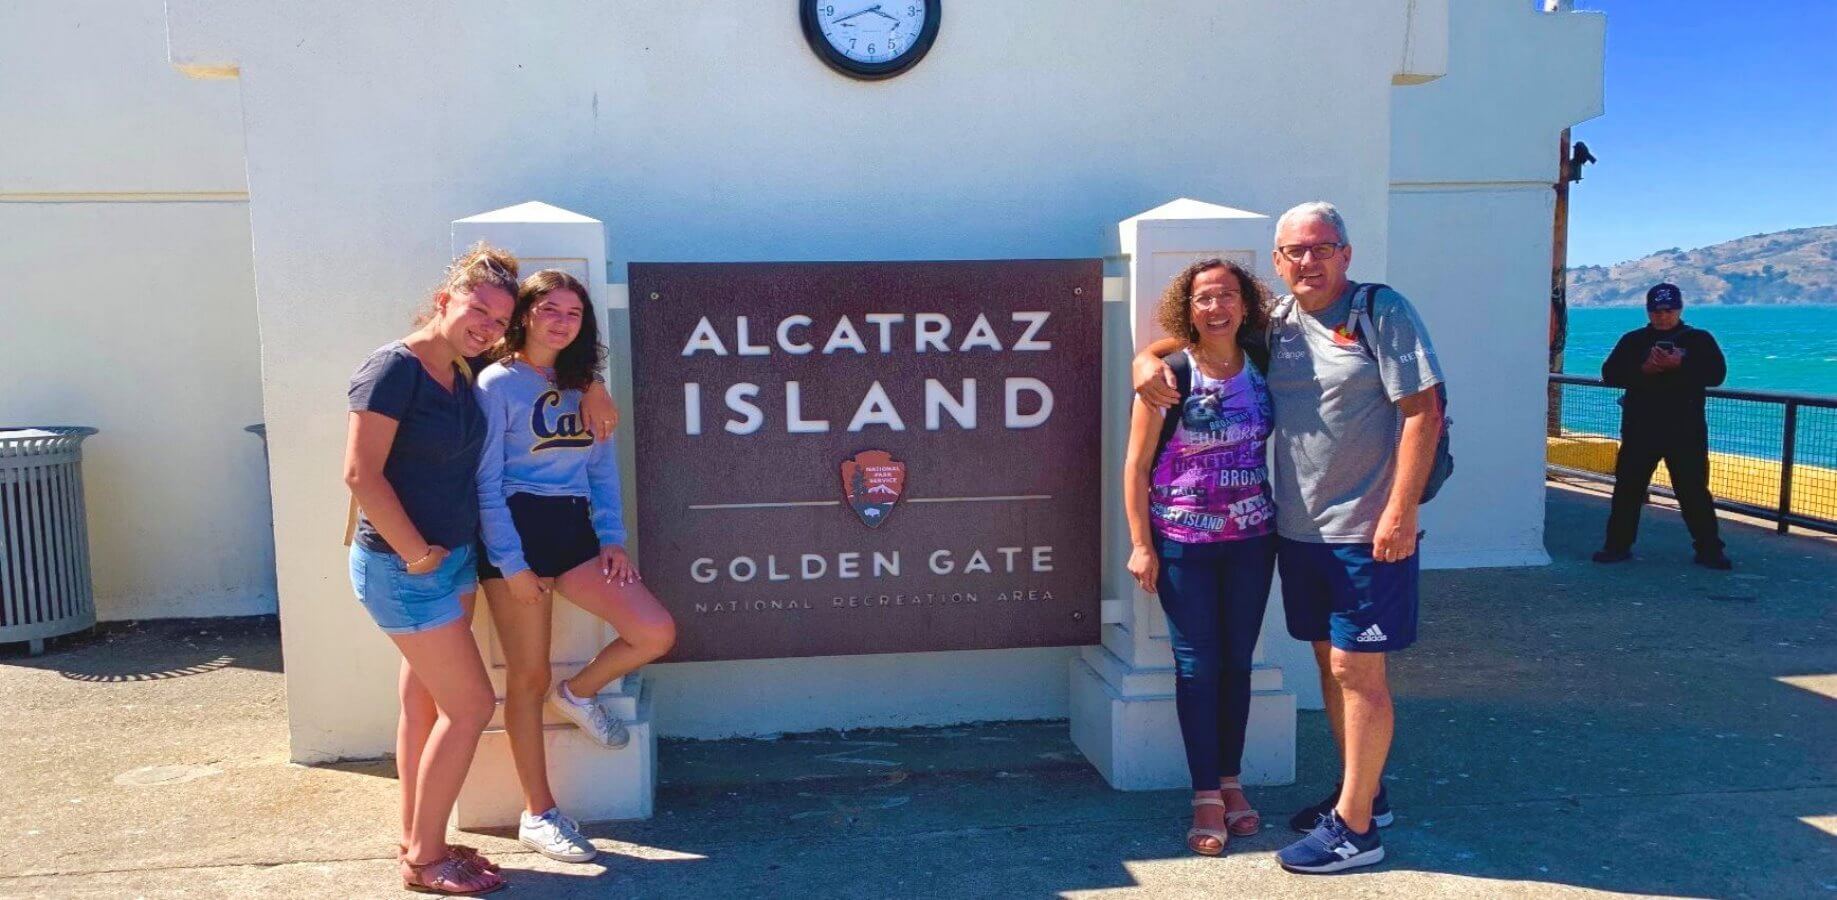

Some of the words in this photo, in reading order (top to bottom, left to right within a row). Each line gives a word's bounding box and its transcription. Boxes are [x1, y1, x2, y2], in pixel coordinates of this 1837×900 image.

[826, 5, 834, 16] 9
[907, 6, 916, 17] 3
[849, 38, 857, 49] 7
[867, 43, 875, 54] 6
[888, 39, 896, 49] 5
[681, 311, 1052, 356] ALCATRAZ
[683, 377, 1055, 435] ISLAND
[1183, 511, 1224, 530] ISLAND
[690, 551, 900, 583] GOLDEN
[928, 545, 1055, 576] GATE
[695, 600, 814, 613] NATIONAL
[832, 592, 979, 607] RECREATION
[997, 590, 1055, 601] AREA
[1357, 634, 1387, 642] adidas
